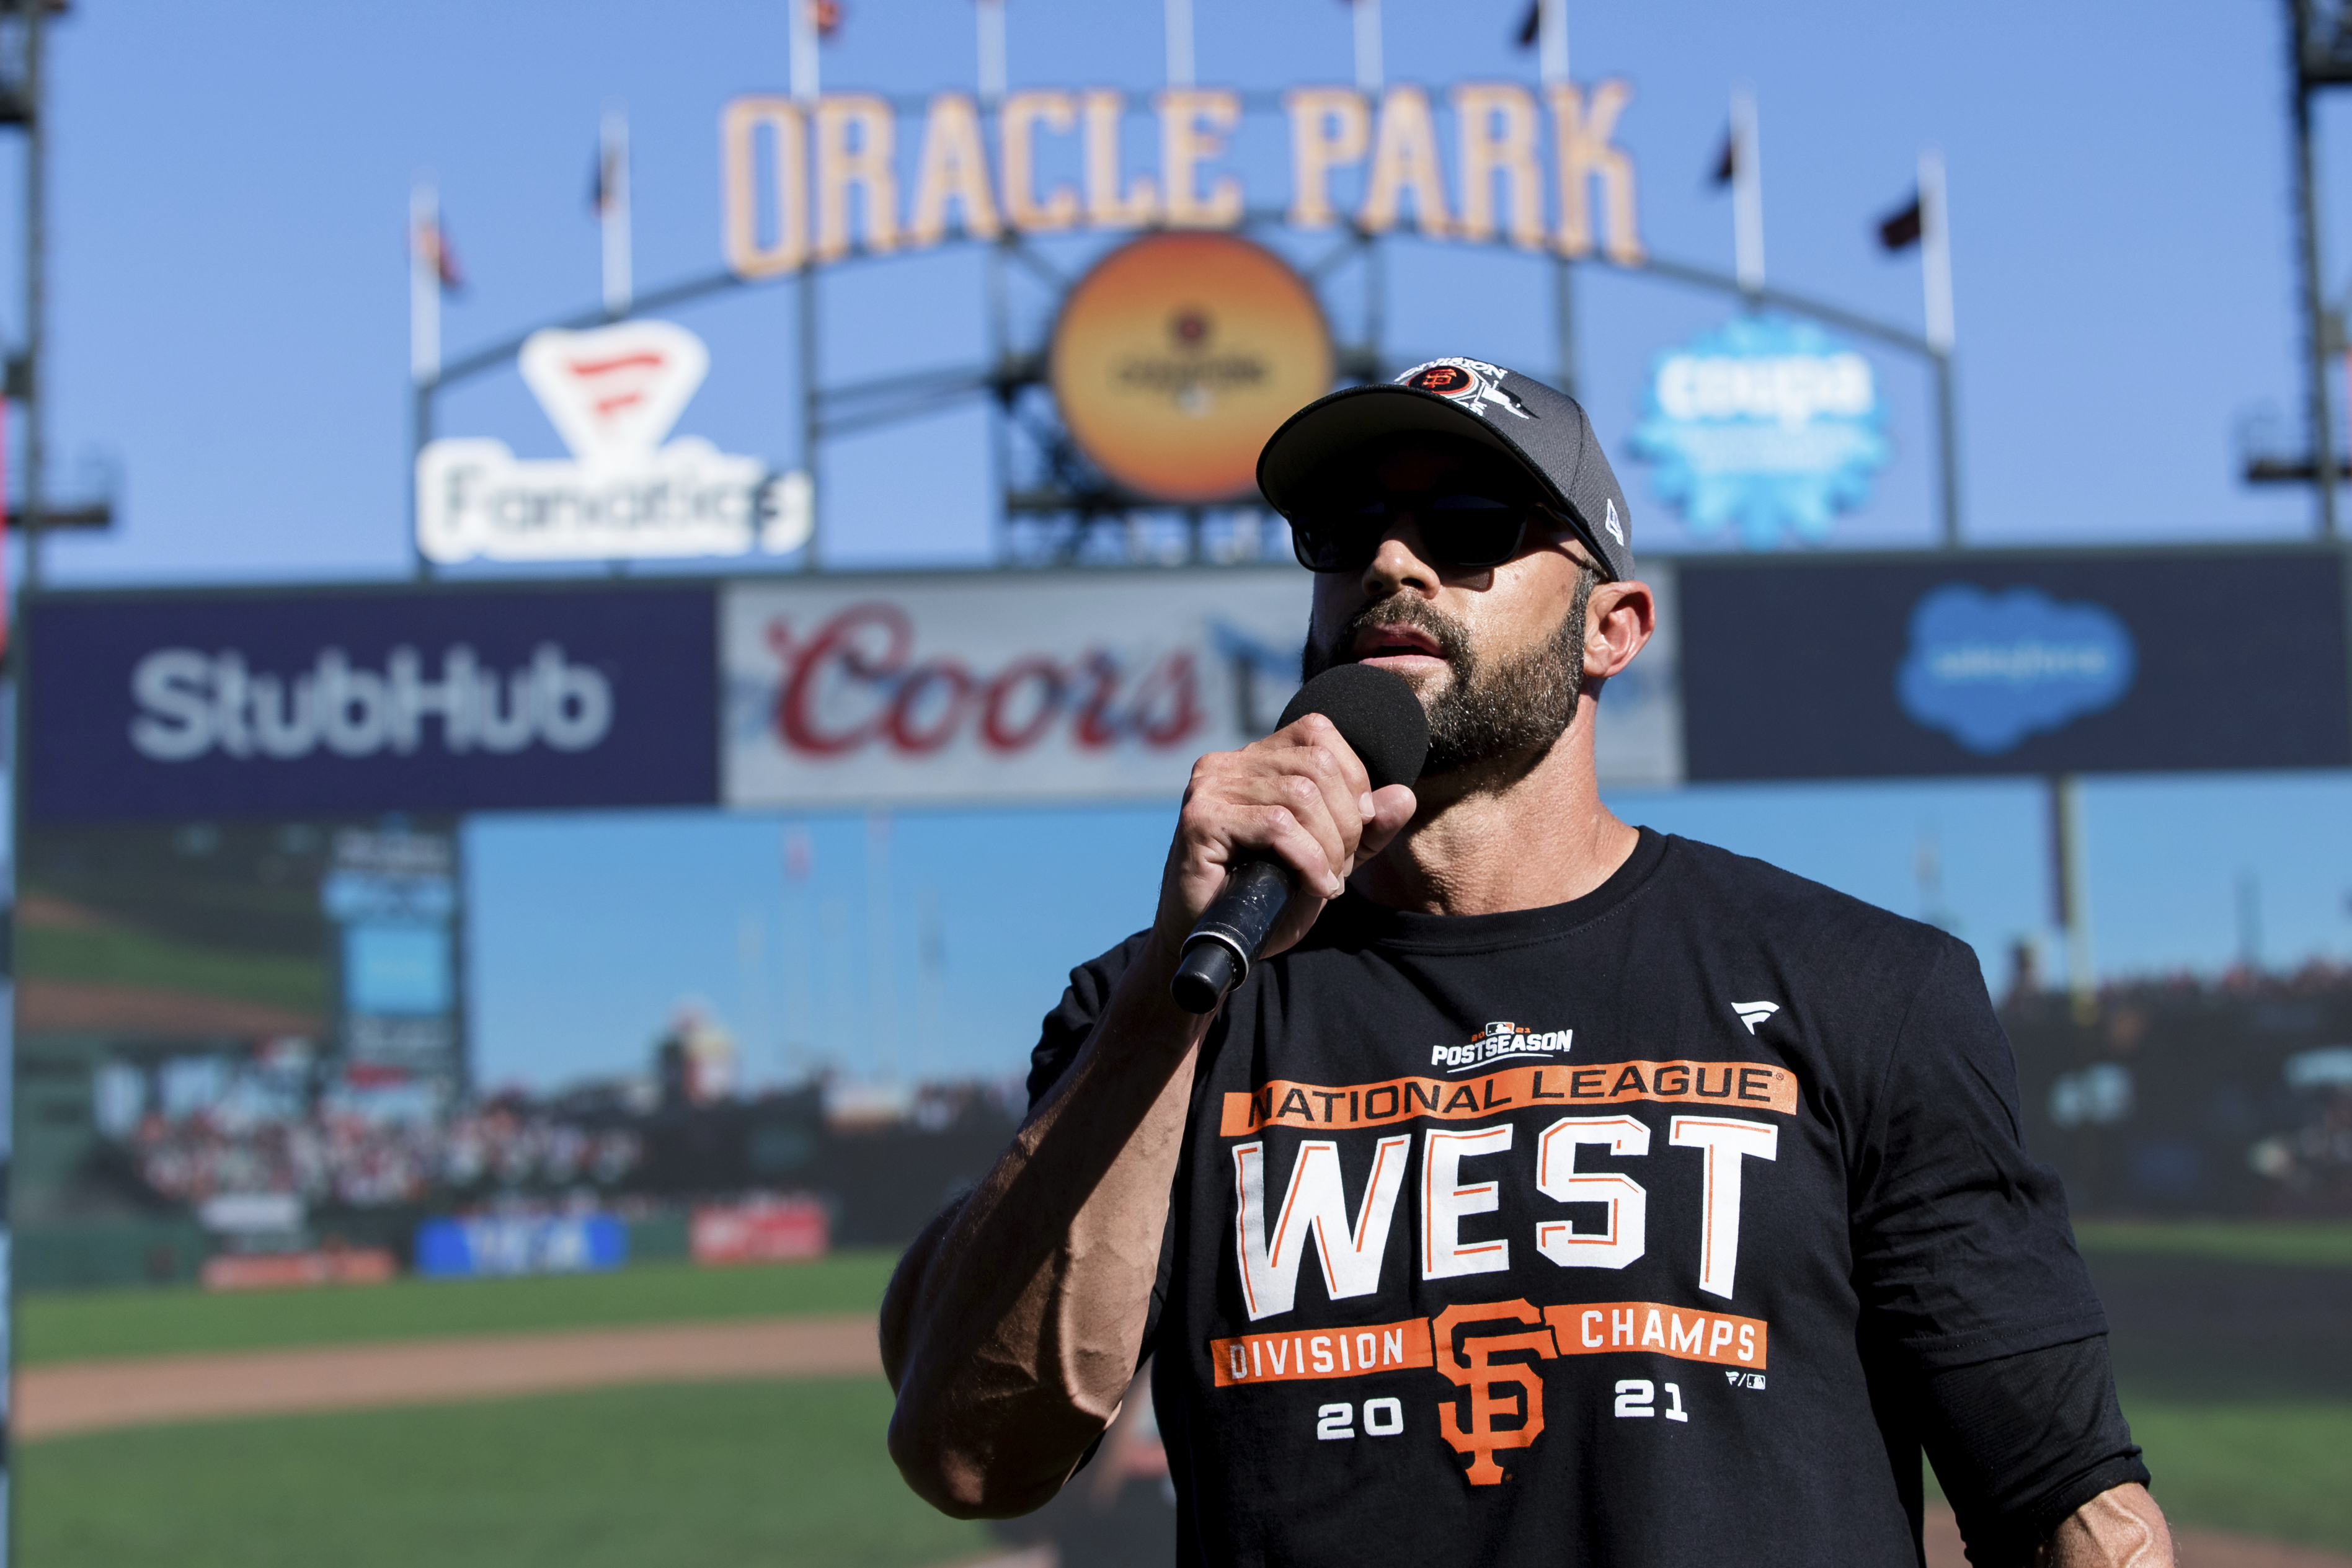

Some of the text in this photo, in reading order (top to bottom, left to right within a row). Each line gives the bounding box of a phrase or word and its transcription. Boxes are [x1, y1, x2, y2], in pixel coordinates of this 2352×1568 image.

[719, 79, 1646, 278] ORACLE PARK
[443, 461, 790, 538] Fanatics
[130, 644, 615, 761] StubHub
[765, 601, 1207, 760] Coors
[1431, 1029, 1573, 1066] POSTSEASON
[1248, 1065, 1772, 1128] NATIONAL LEAGUE
[1232, 1115, 1778, 1321] WEST
[1230, 1328, 1403, 1380] DIVISION
[1581, 1308, 1755, 1362] CHAMPS
[1317, 1379, 1688, 1440] 20 21
